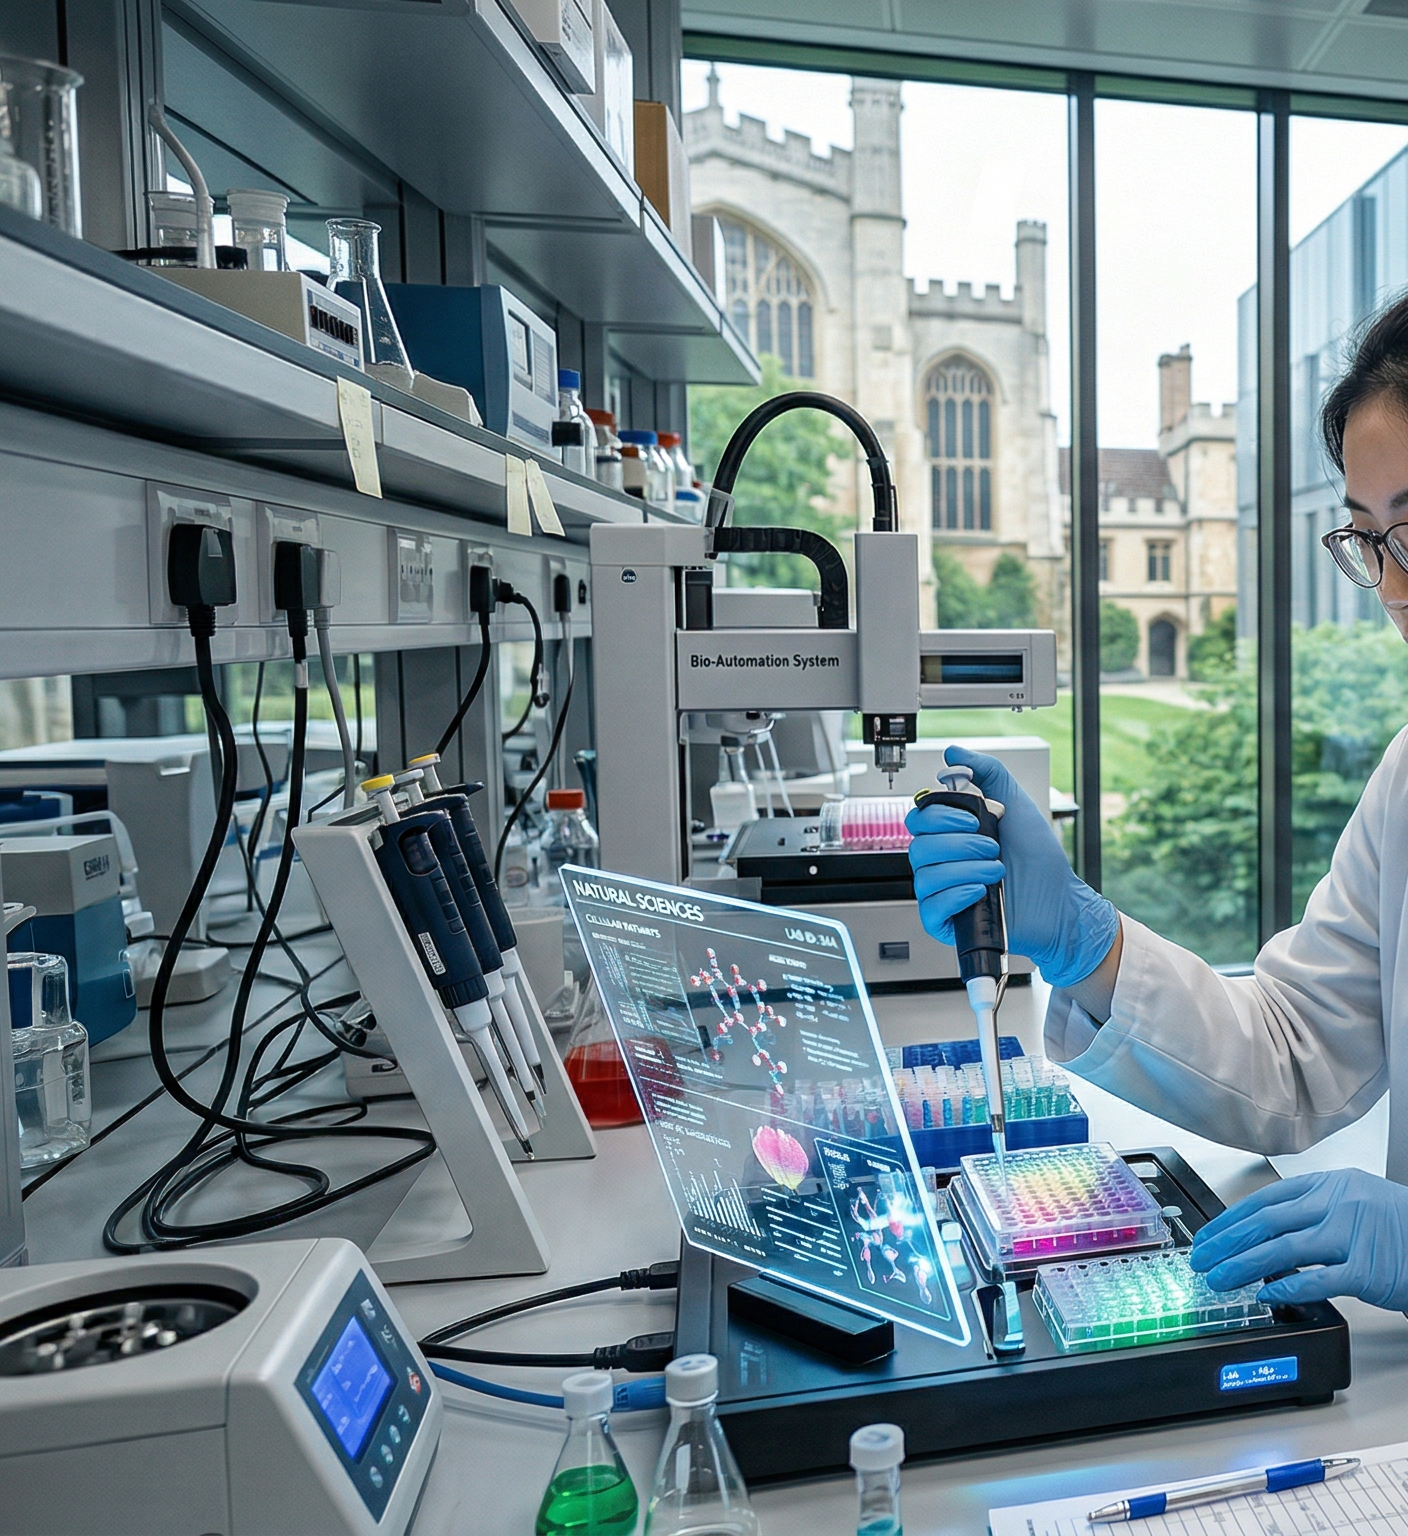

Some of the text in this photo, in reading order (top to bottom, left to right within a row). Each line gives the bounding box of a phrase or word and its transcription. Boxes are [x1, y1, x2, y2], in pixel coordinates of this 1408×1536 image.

[690, 654, 840, 671] Bio-Automation System
[572, 879, 637, 907] NATURAL
